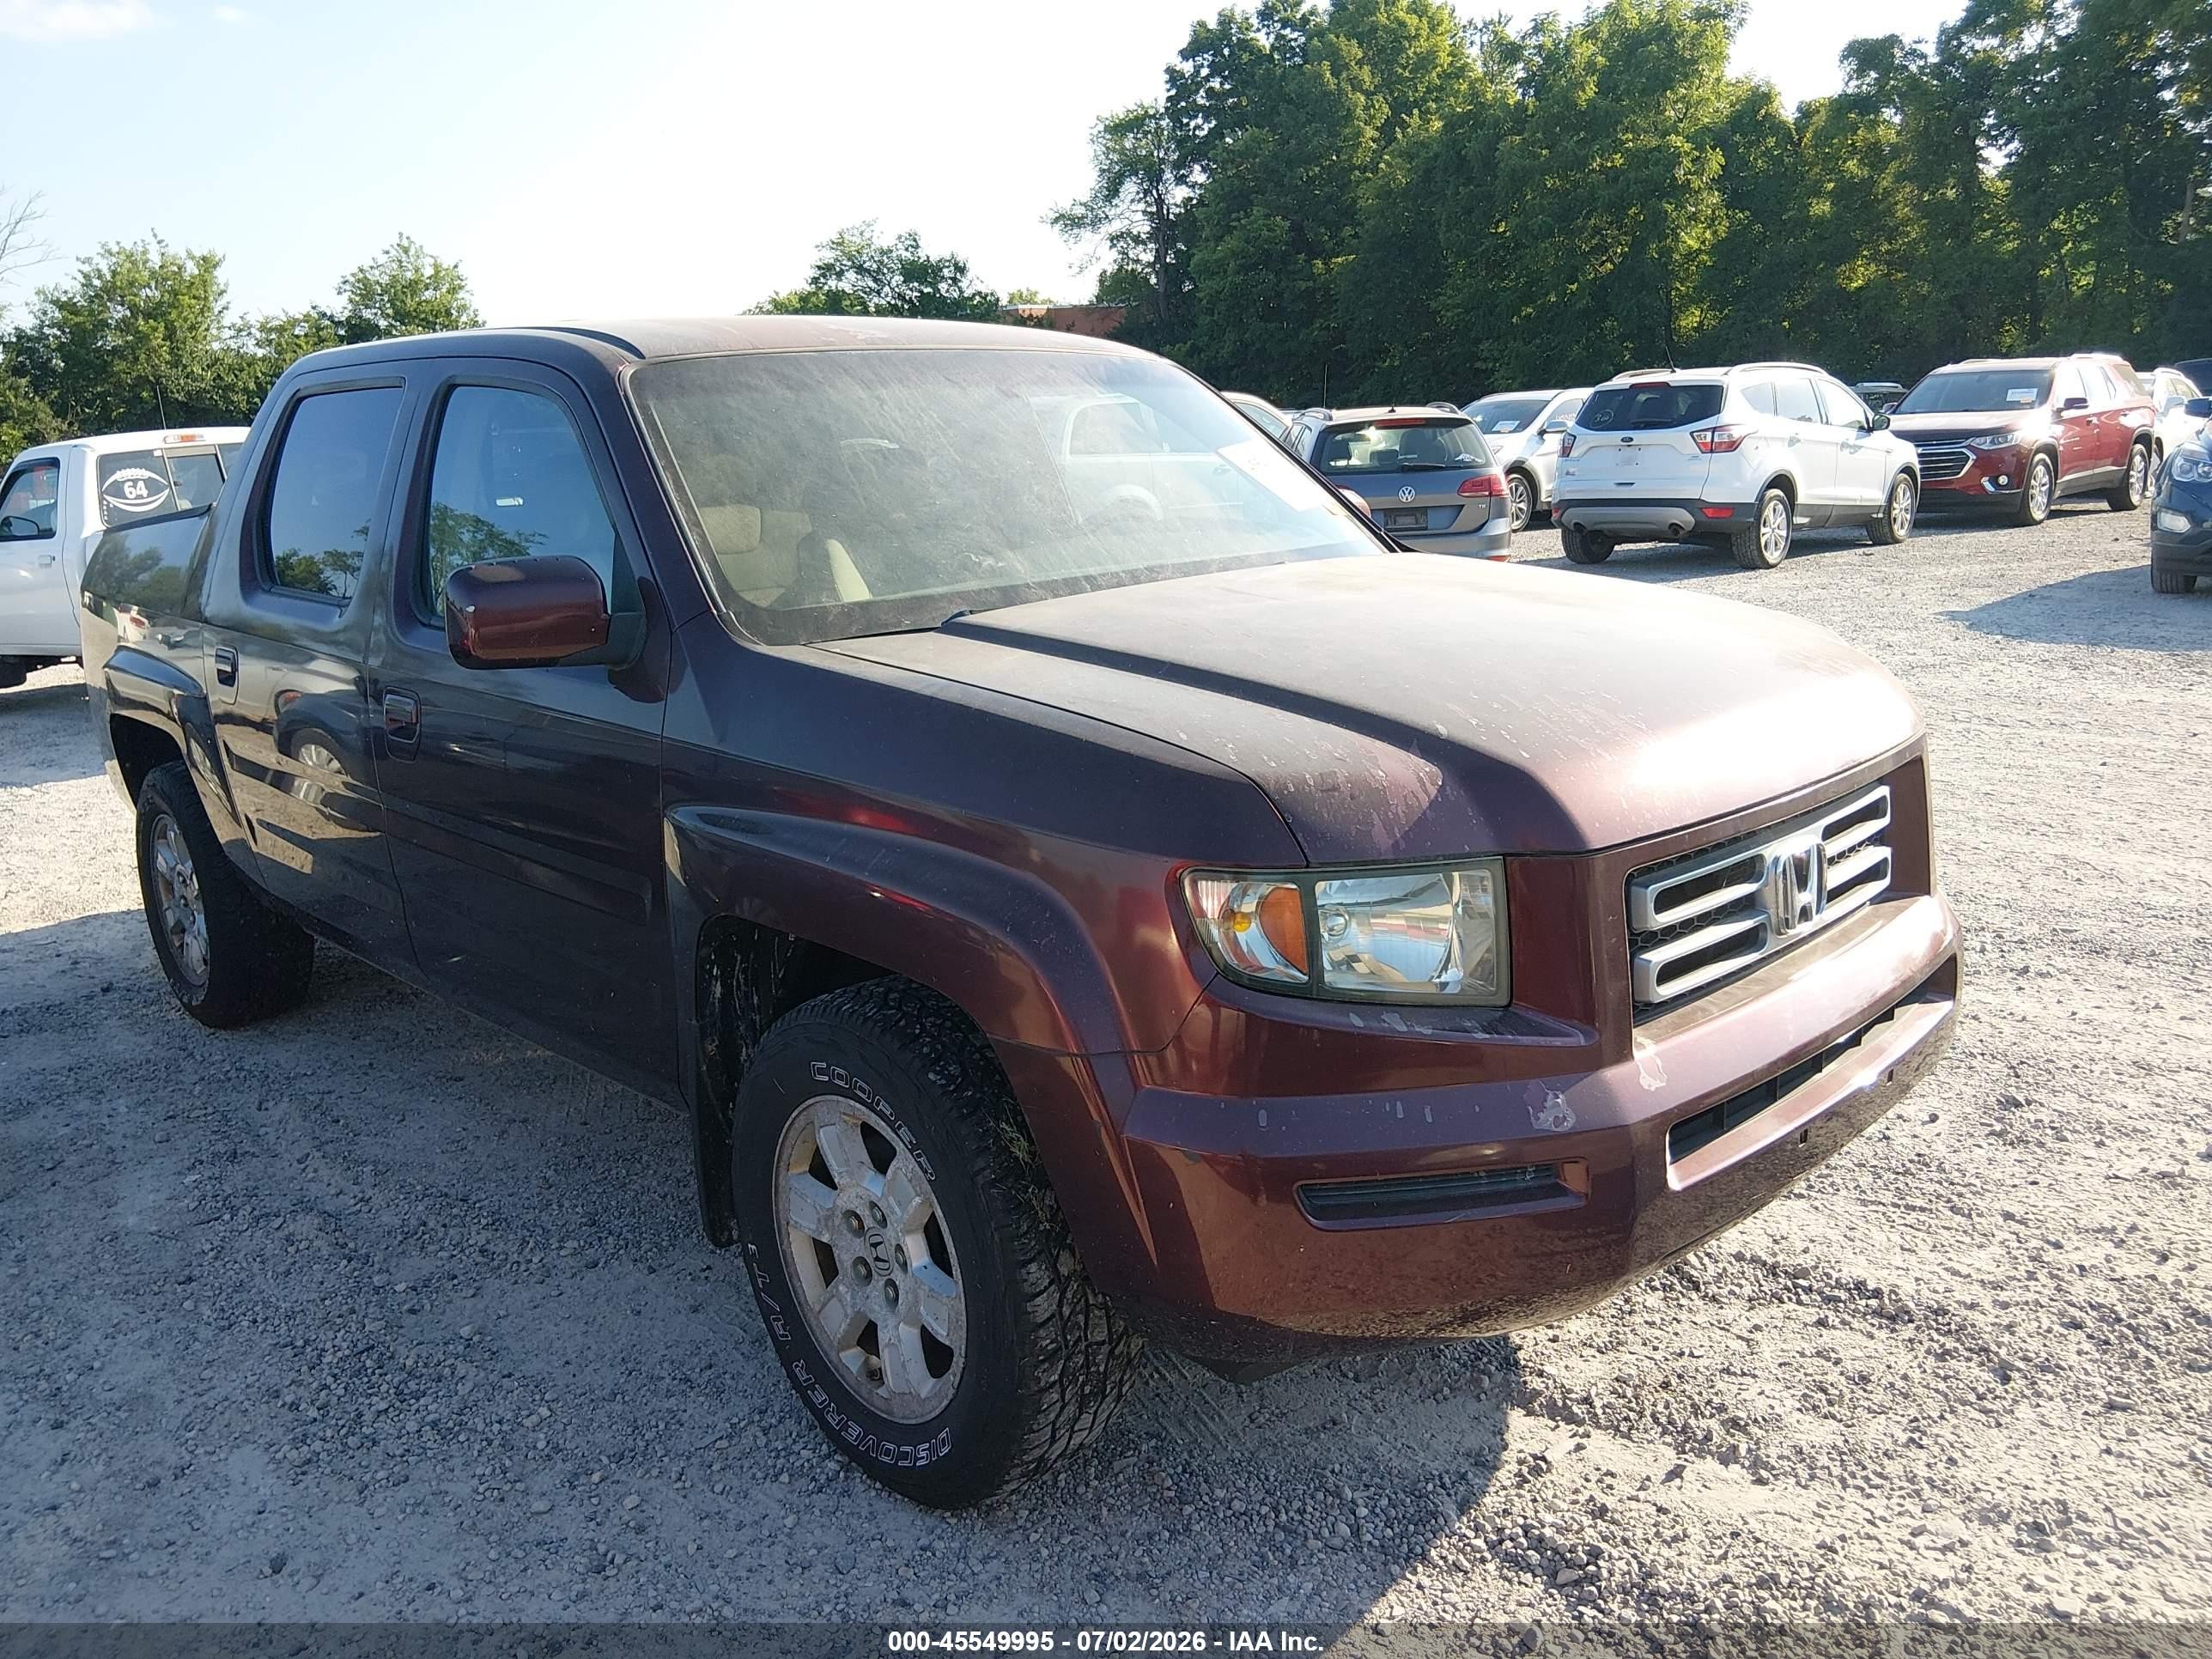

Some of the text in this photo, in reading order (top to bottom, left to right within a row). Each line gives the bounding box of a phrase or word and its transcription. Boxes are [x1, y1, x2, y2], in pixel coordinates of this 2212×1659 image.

[124, 480, 149, 499] 64
[810, 1061, 936, 1181] COOPER
[792, 1358, 952, 1467] DISCOVERER
